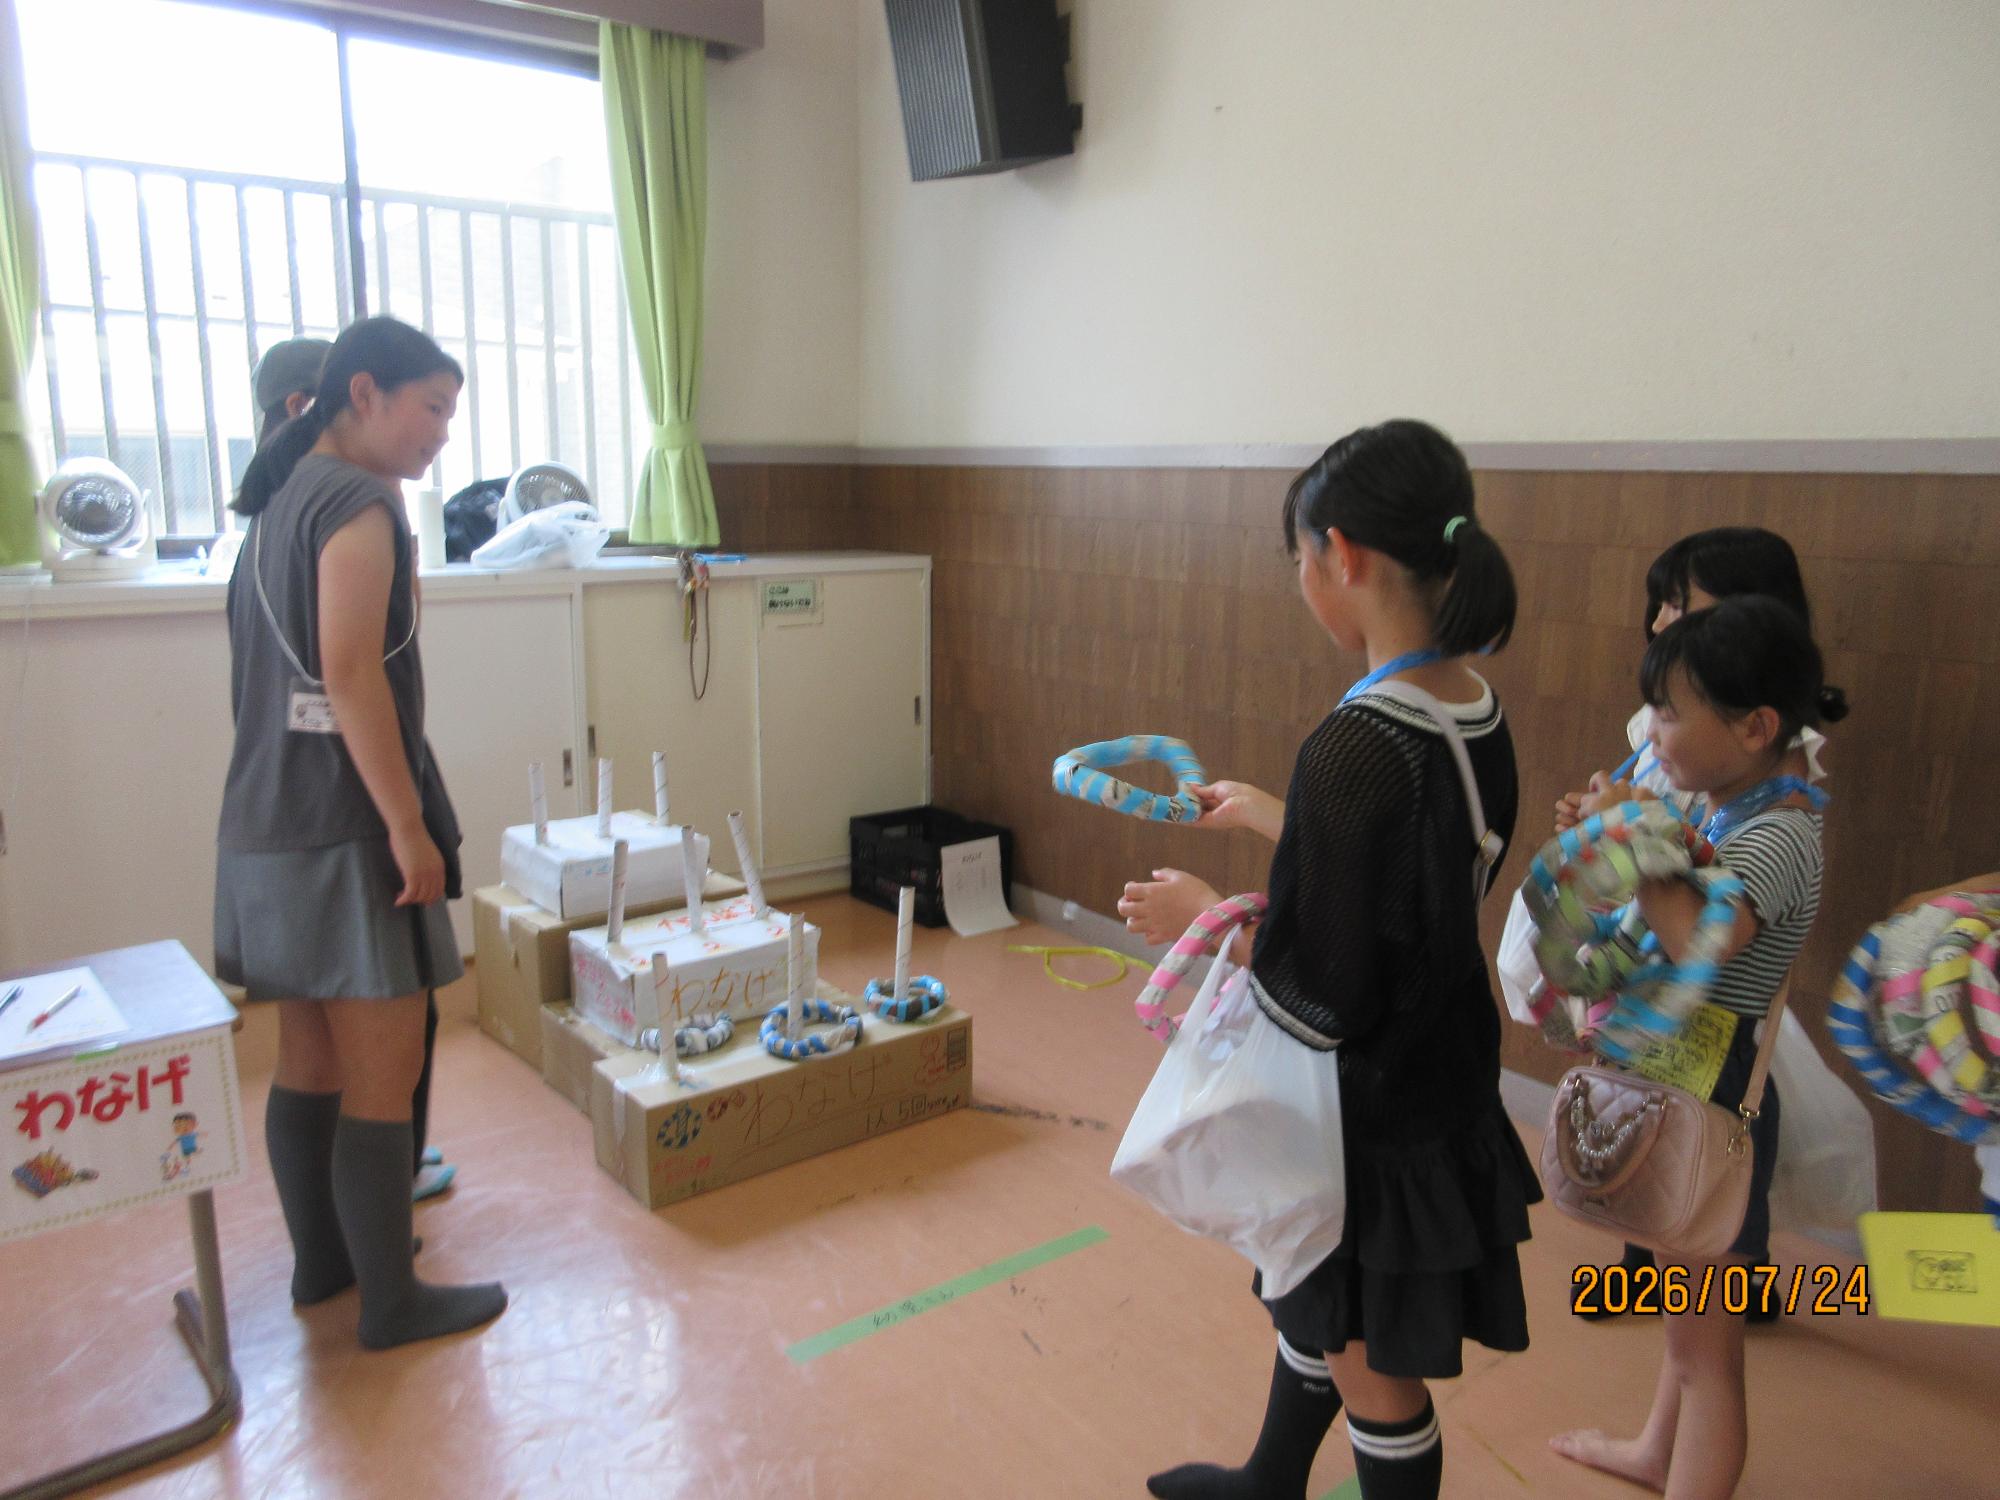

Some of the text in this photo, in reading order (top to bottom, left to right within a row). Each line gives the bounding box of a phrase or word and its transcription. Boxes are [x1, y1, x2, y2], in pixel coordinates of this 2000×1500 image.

[15, 1053, 191, 1140] わなげ
[741, 1051, 894, 1147] わなげ
